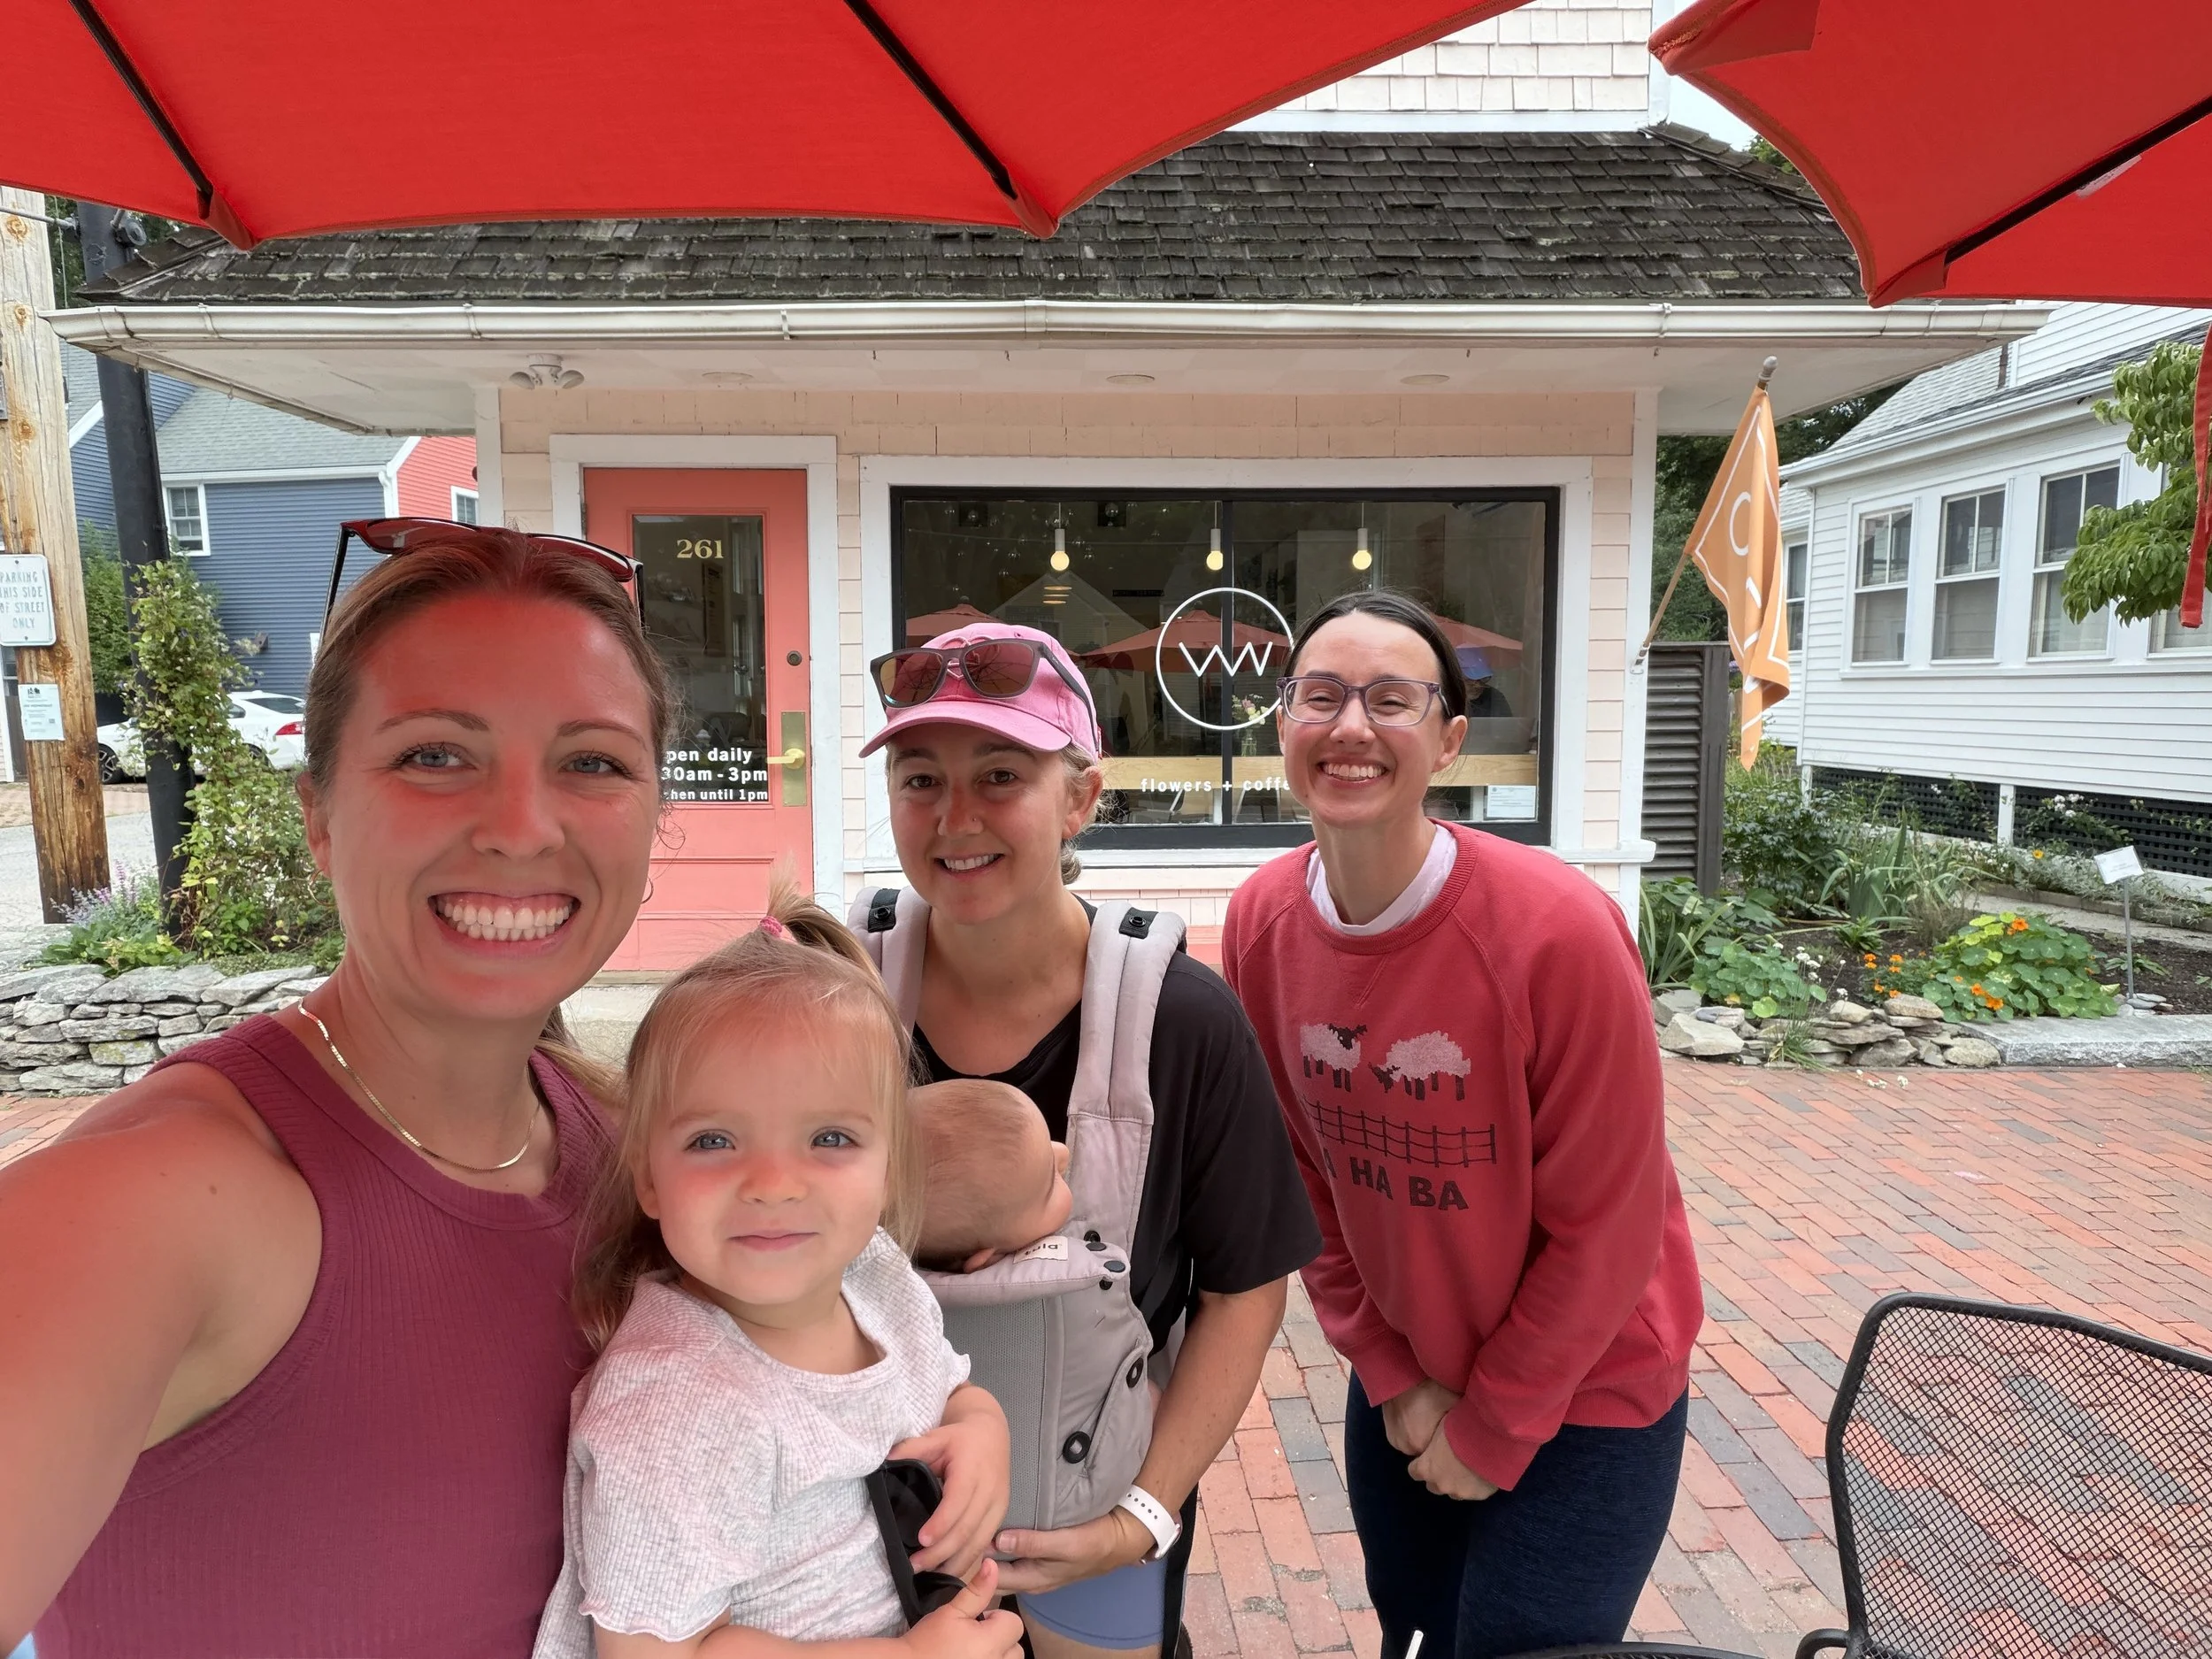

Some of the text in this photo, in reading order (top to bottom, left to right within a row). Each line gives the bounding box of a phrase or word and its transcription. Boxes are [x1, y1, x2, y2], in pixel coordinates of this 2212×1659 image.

[676, 539, 724, 558] 261
[0, 572, 38, 583] PARKING
[22, 586, 42, 597] SIDE
[14, 602, 44, 613] STREET
[12, 618, 35, 629] ONLY
[665, 748, 752, 764] pen daily
[728, 766, 768, 785] 3pm
[1140, 778, 1212, 793] flowers
[1242, 777, 1290, 791] coffe
[700, 788, 733, 801] until
[739, 788, 768, 802] 1pm
